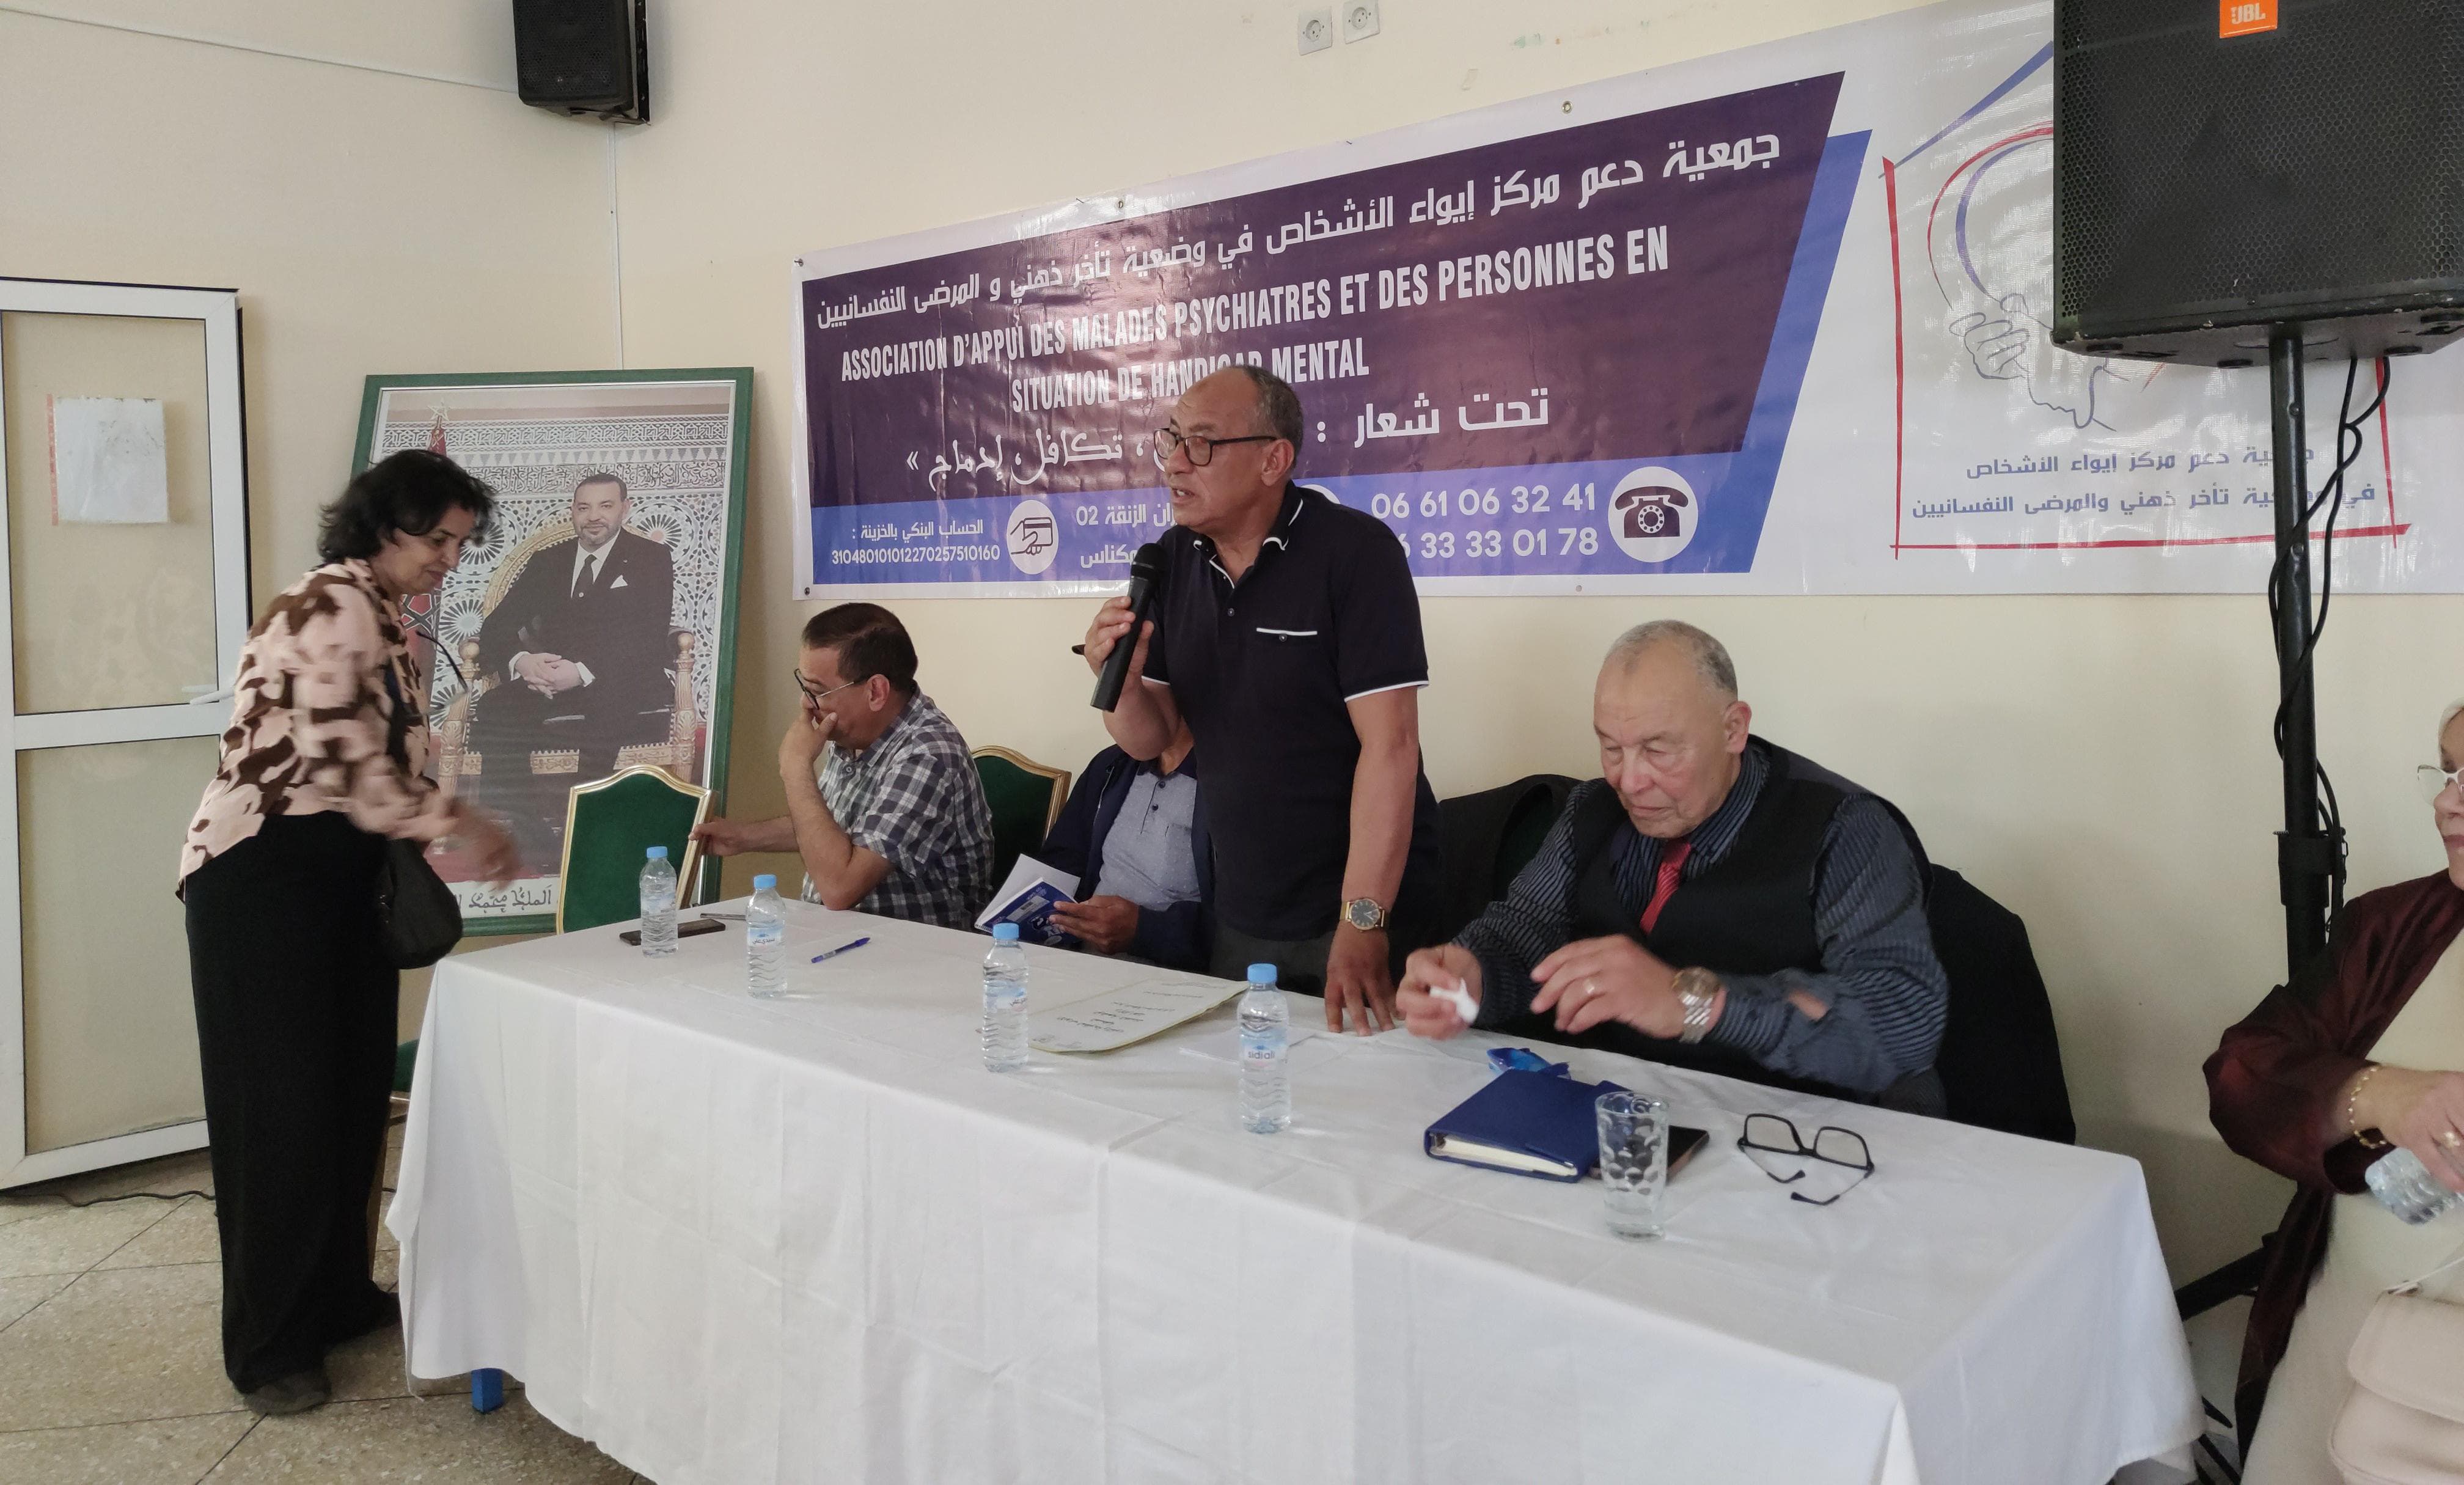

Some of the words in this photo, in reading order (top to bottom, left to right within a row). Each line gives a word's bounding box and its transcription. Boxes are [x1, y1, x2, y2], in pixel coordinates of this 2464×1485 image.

[2231, 3, 2266, 24] JBL
[1663, 134, 1780, 182] جمعية
[1491, 169, 1560, 216] مركز
[1579, 160, 1643, 209] دعم
[1409, 180, 1474, 226] إيواء
[1267, 196, 1393, 254] الأشخاص
[1123, 237, 1205, 277] وضعية
[1218, 224, 1253, 270] في
[1073, 241, 1110, 288] تأخر
[914, 273, 979, 314] المرضى
[989, 277, 1000, 302] و
[1011, 260, 1062, 304] ذهني
[818, 285, 906, 329] النفسانيين
[842, 337, 947, 381] ASSOCIATION
[953, 326, 1025, 367] D'APPUI
[1030, 319, 1065, 356] DES
[1072, 304, 1167, 351] MALADES
[1175, 279, 1331, 338] PSYCHIATRES
[1340, 273, 1370, 315] ET
[1379, 264, 1428, 310] DES
[1439, 234, 1614, 301] PERSONNES
[1627, 225, 1668, 274] EN
[1012, 369, 1109, 413] SITUATION
[1117, 365, 1143, 402] DE
[1272, 338, 1369, 384] MENTAL
[1354, 392, 1439, 448] شعار
[1459, 387, 1548, 431] تحت
[928, 435, 1002, 492] إدماج
[1967, 455, 2058, 479] الأشخاص
[2071, 453, 2117, 474] إيواء
[2129, 452, 2175, 472] مركز
[2188, 450, 2229, 473] دعم
[1371, 493, 1410, 519] 06
[1420, 491, 1447, 518] 61
[1458, 488, 1500, 516] 06
[1511, 485, 1550, 513] 32
[1562, 482, 1595, 511] 41
[1913, 496, 2013, 518] النفسانيين
[2025, 493, 2108, 515] والمرضى
[2120, 490, 2176, 515] ذهني
[2189, 482, 2229, 509] تأخر
[2342, 483, 2375, 508] في
[860, 523, 897, 541] بالخزينة
[902, 521, 933, 543] البنكي
[939, 519, 983, 535] الحساب
[1076, 505, 1099, 526] 02
[1105, 503, 1146, 528] الزنقة
[1420, 532, 1455, 559] 33
[1465, 530, 1502, 558] 33
[1513, 529, 1547, 557] 01
[1558, 527, 1599, 556] 78
